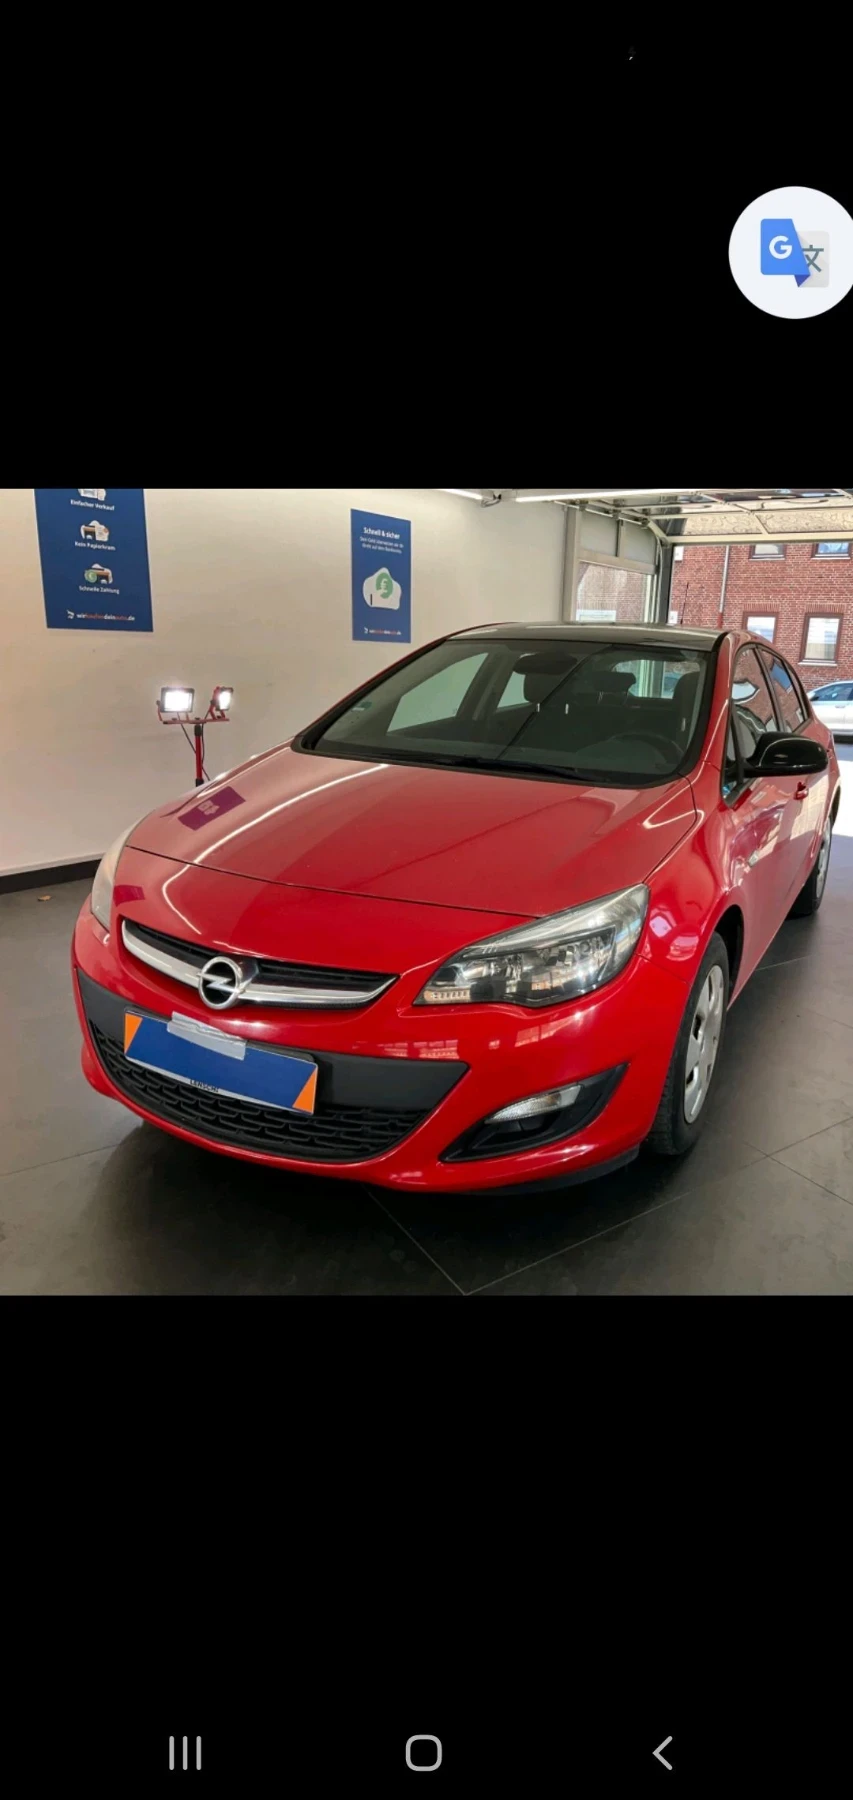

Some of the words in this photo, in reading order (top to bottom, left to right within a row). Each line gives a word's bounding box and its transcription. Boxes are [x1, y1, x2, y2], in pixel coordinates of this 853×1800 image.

[70, 499, 95, 508] Einfacher
[95, 502, 115, 511] Verkauf
[363, 527, 381, 536] Schnell
[87, 542, 116, 551] Papierkram
[79, 585, 99, 593] Schnelle
[100, 587, 120, 595] Zahlung
